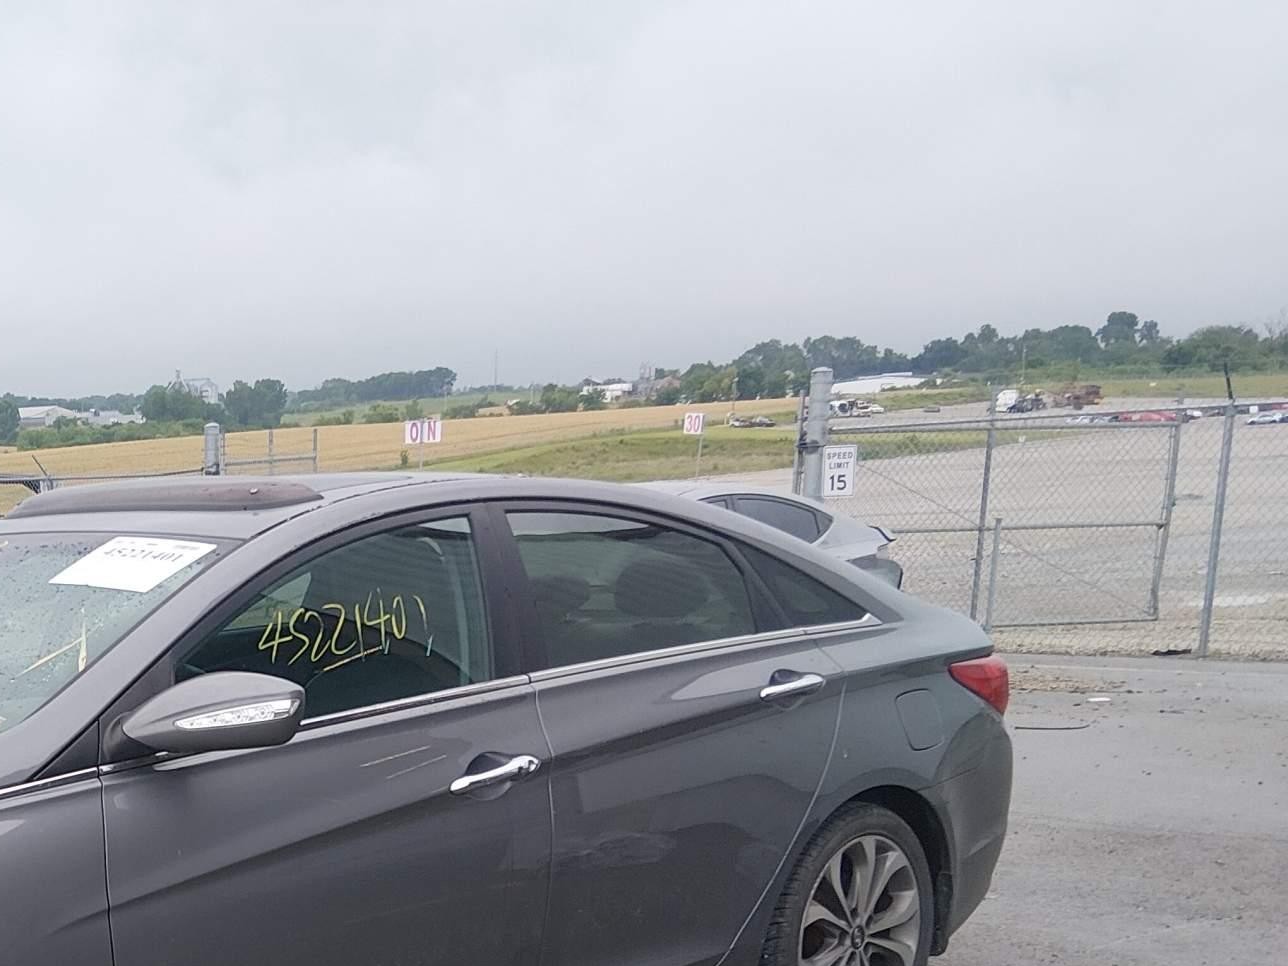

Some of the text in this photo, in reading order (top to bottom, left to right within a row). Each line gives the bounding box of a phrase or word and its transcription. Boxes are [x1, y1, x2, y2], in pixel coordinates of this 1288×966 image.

[686, 415, 701, 433] 30
[827, 451, 853, 460] SPEED
[828, 461, 850, 470] LIMIT
[829, 474, 847, 491] 15
